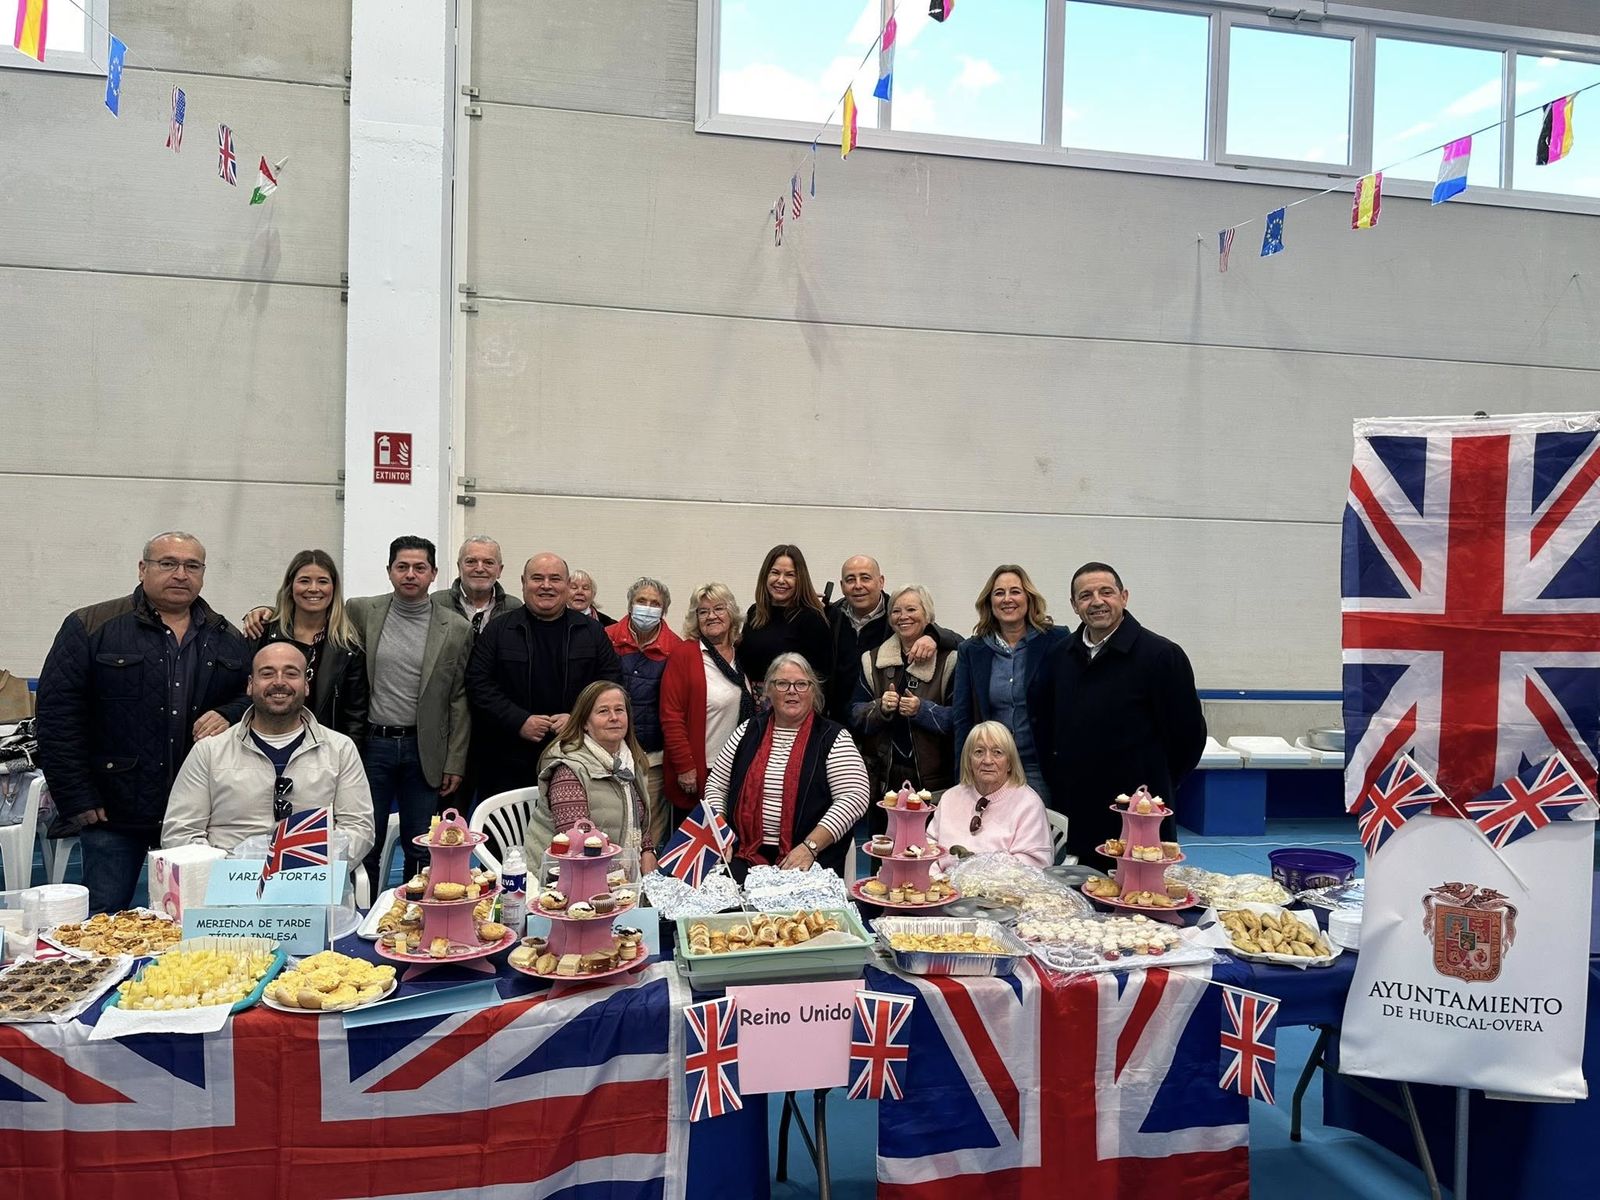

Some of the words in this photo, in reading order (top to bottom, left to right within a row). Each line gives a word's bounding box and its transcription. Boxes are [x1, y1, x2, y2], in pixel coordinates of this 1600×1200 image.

[375, 471, 410, 480] EXTINTOR
[279, 872, 326, 881] TORTAS
[196, 919, 254, 929] MERIENDA
[258, 919, 273, 928] DE
[277, 919, 312, 928] TARDE
[250, 932, 298, 941] INGLESA
[1368, 981, 1563, 1015] AYUNTAMIENTO
[740, 1007, 791, 1026] Reino
[800, 1002, 852, 1023] Unido
[1382, 1004, 1403, 1018] DE
[1409, 1008, 1544, 1032] HUERCAL-OVERA
